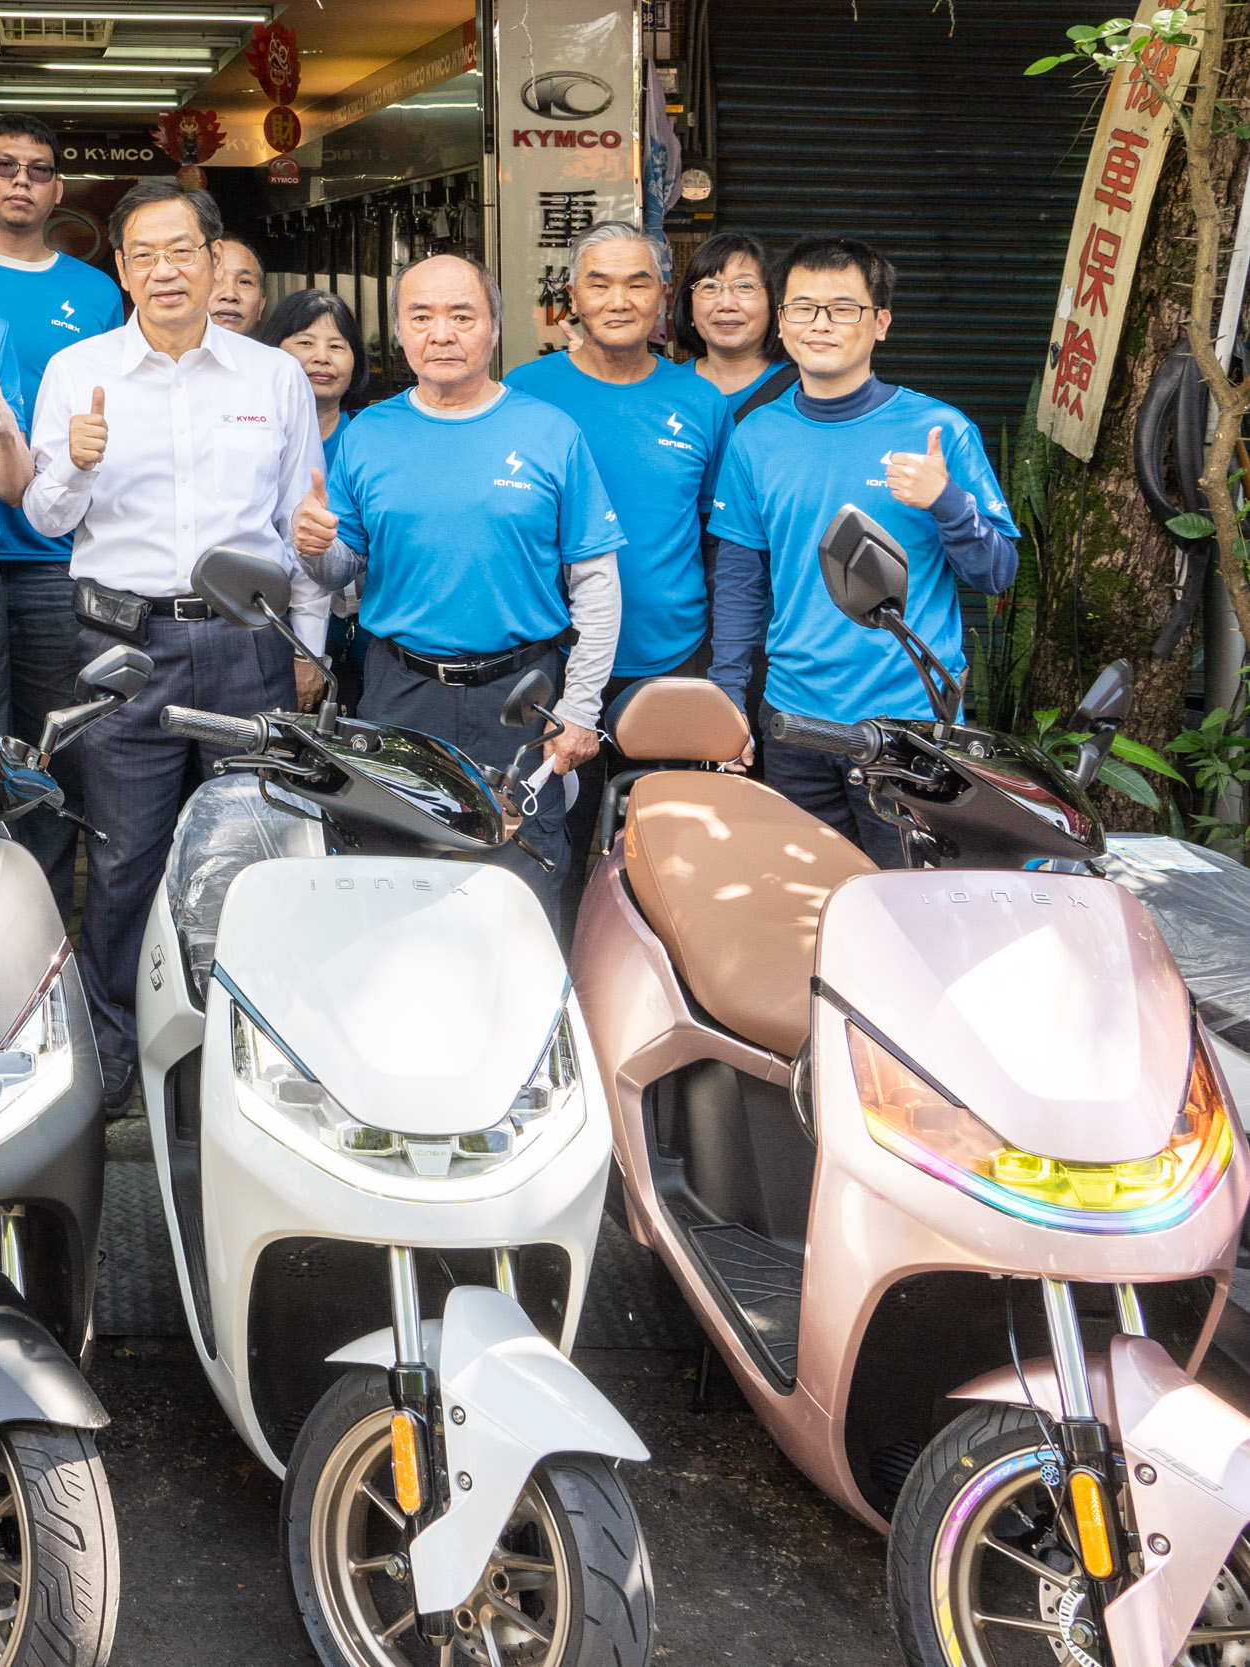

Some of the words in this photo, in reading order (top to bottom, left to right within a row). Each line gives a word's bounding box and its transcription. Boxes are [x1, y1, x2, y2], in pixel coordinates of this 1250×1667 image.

[403, 66, 425, 94] KYMCO
[426, 54, 450, 83] KYMCO
[270, 114, 295, 146] 財
[513, 129, 622, 149] KYMCO
[84, 147, 154, 160] KYMCO
[270, 176, 299, 185] KYMCO
[236, 415, 267, 423] KYMCO
[866, 478, 888, 488] ion
[310, 876, 469, 896] ionex
[920, 889, 1089, 909] ionex
